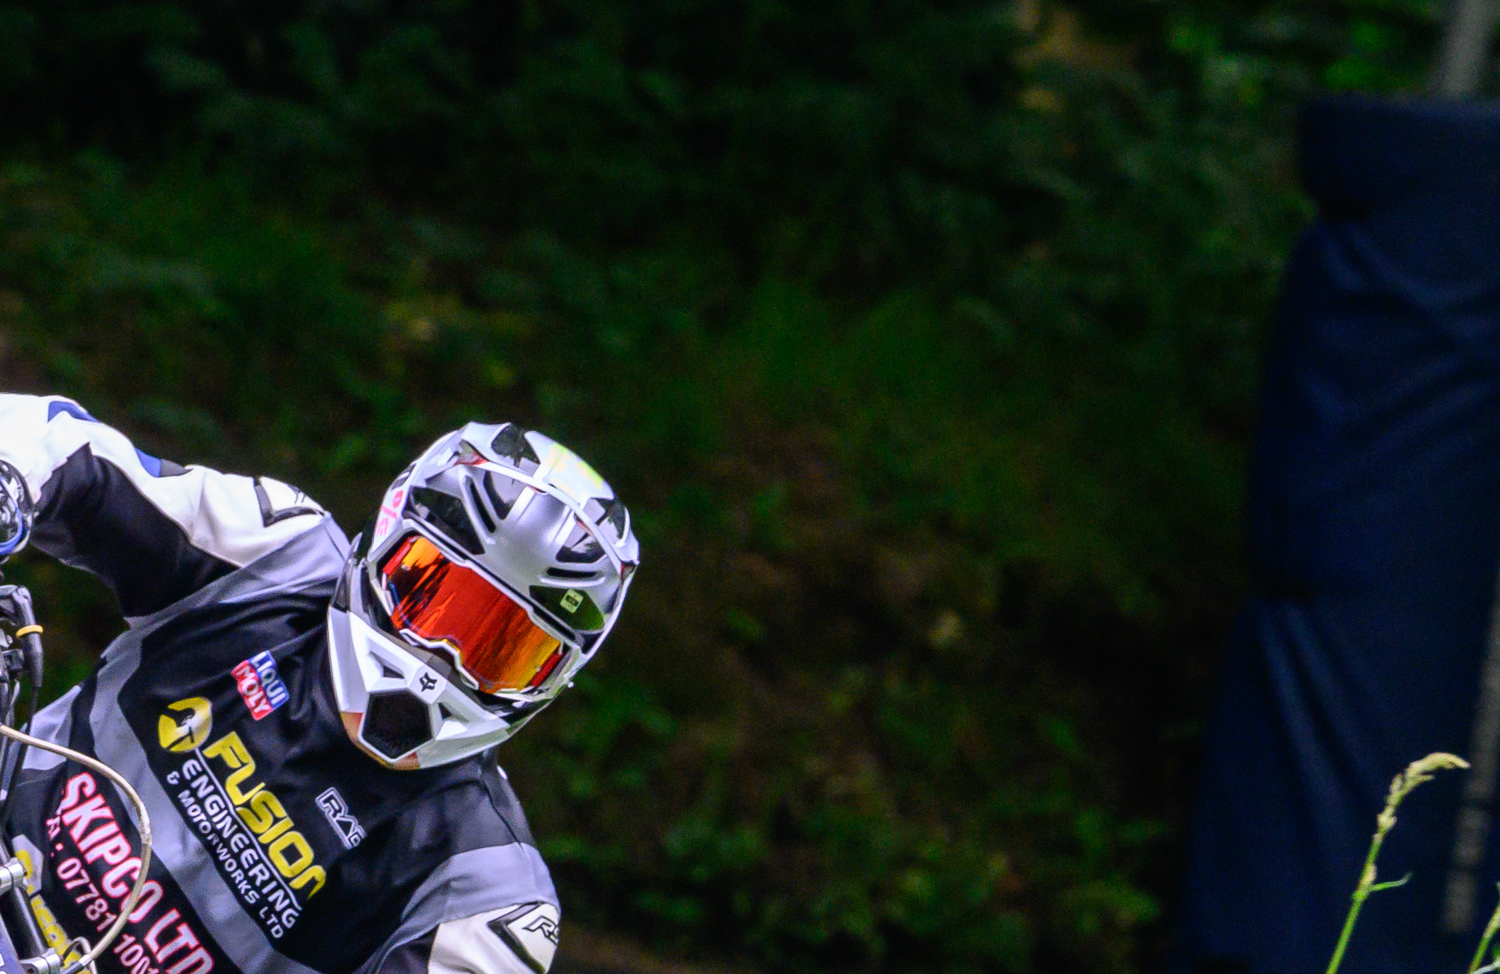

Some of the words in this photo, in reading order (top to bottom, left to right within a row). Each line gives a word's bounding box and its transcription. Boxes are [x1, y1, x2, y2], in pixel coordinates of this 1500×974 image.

[235, 665, 271, 714] MOLY
[250, 651, 287, 705] LIQUI
[59, 771, 164, 924] SKIPCO
[182, 758, 299, 929] ENGINEERING
[56, 857, 117, 932] 07781
[259, 906, 284, 939] LTD
